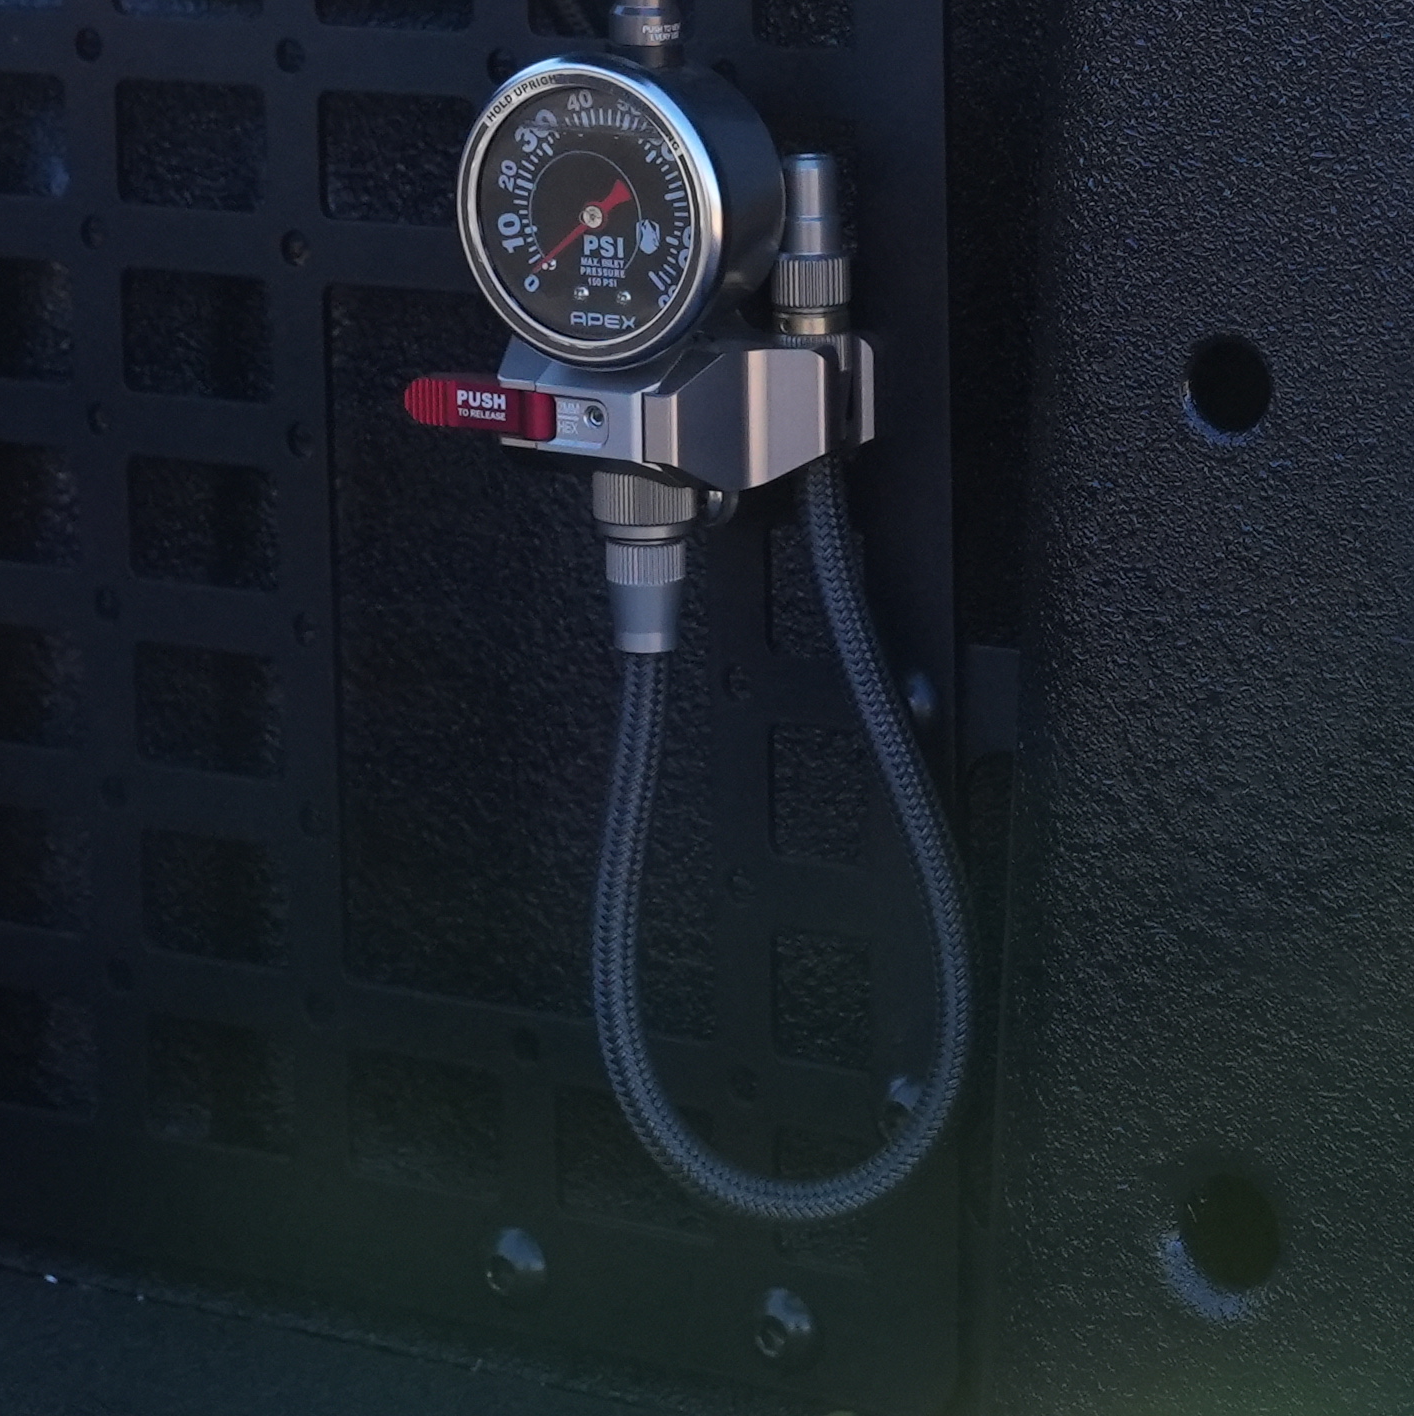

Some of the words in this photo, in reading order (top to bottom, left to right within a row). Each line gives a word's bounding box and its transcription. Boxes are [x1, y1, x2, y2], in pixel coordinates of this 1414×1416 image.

[487, 94, 513, 123] HOLD
[567, 90, 593, 112] 40
[515, 109, 558, 153] 30
[498, 159, 517, 192] 20
[498, 212, 525, 253] 10
[583, 234, 624, 259] PSI
[580, 266, 626, 278] PRESSURE
[524, 274, 540, 292] 0
[603, 278, 617, 287] PSI
[570, 311, 636, 330] APEX
[457, 390, 506, 409] PUSH
[458, 408, 469, 416] TO
[470, 409, 506, 421] RELEASE
[557, 420, 579, 434] HEX
